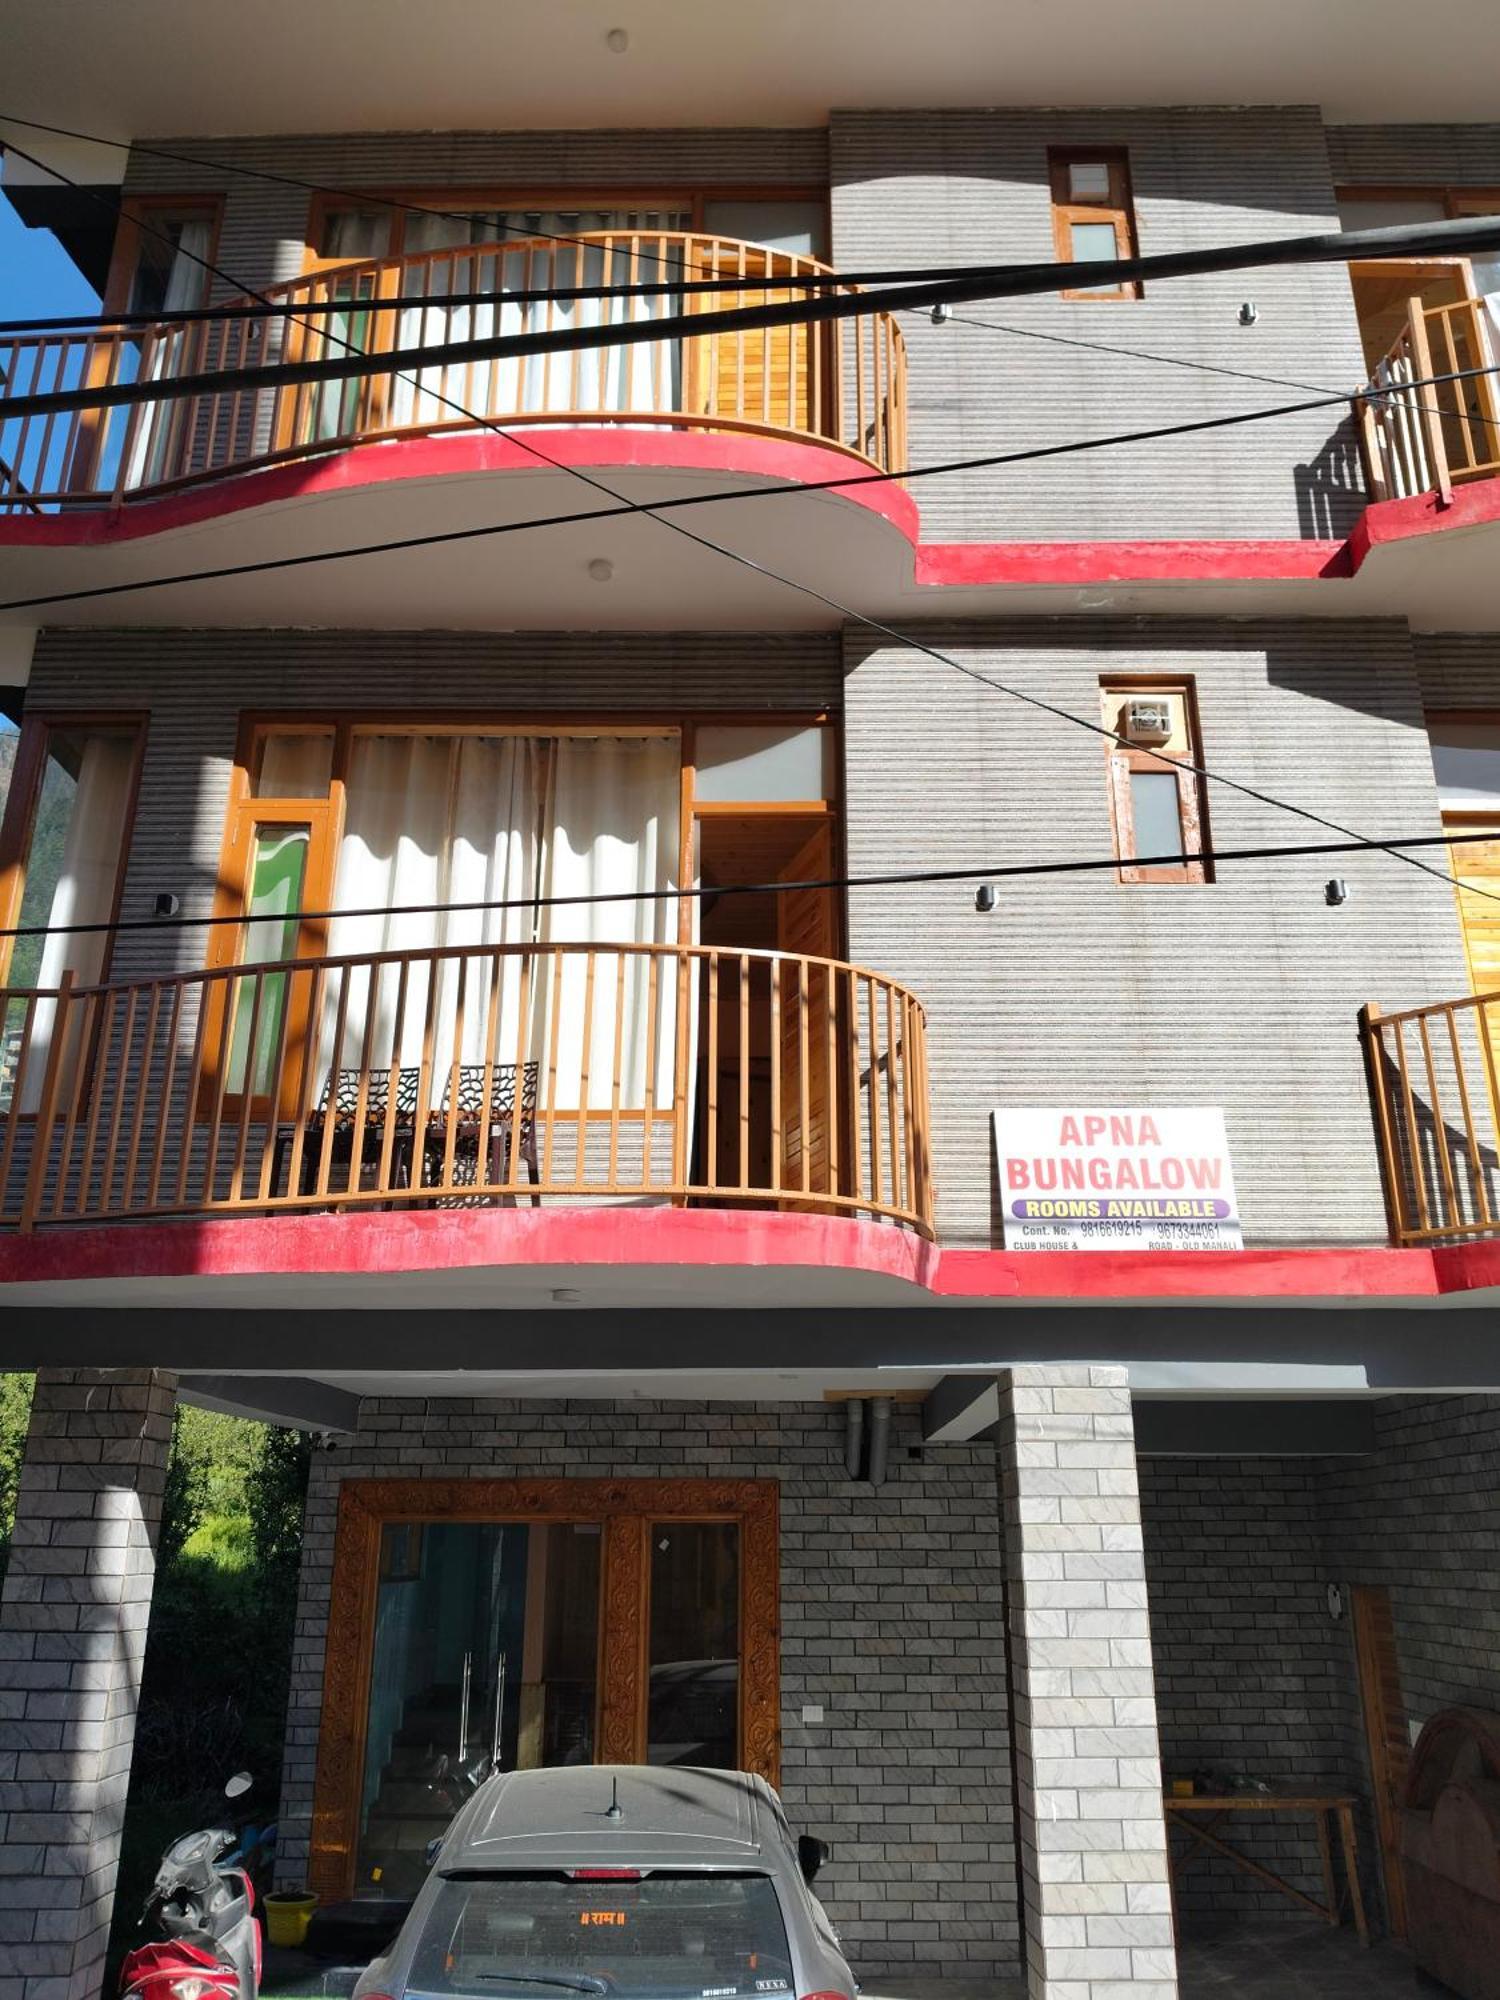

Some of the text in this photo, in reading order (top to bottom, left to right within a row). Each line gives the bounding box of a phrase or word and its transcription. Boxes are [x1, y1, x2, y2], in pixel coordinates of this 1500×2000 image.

[1059, 1115, 1162, 1146] APNA
[1006, 1158, 1222, 1190] BUNGALOW
[1026, 1201, 1216, 1217] ROOMS AVAILABLE
[1022, 1225, 1050, 1236] Cont.
[1013, 1241, 1036, 1250] CLUB
[1039, 1241, 1069, 1250] HOUSE
[1071, 1241, 1078, 1250] &
[1148, 1241, 1173, 1250] ROAD
[1182, 1241, 1200, 1250] OLD
